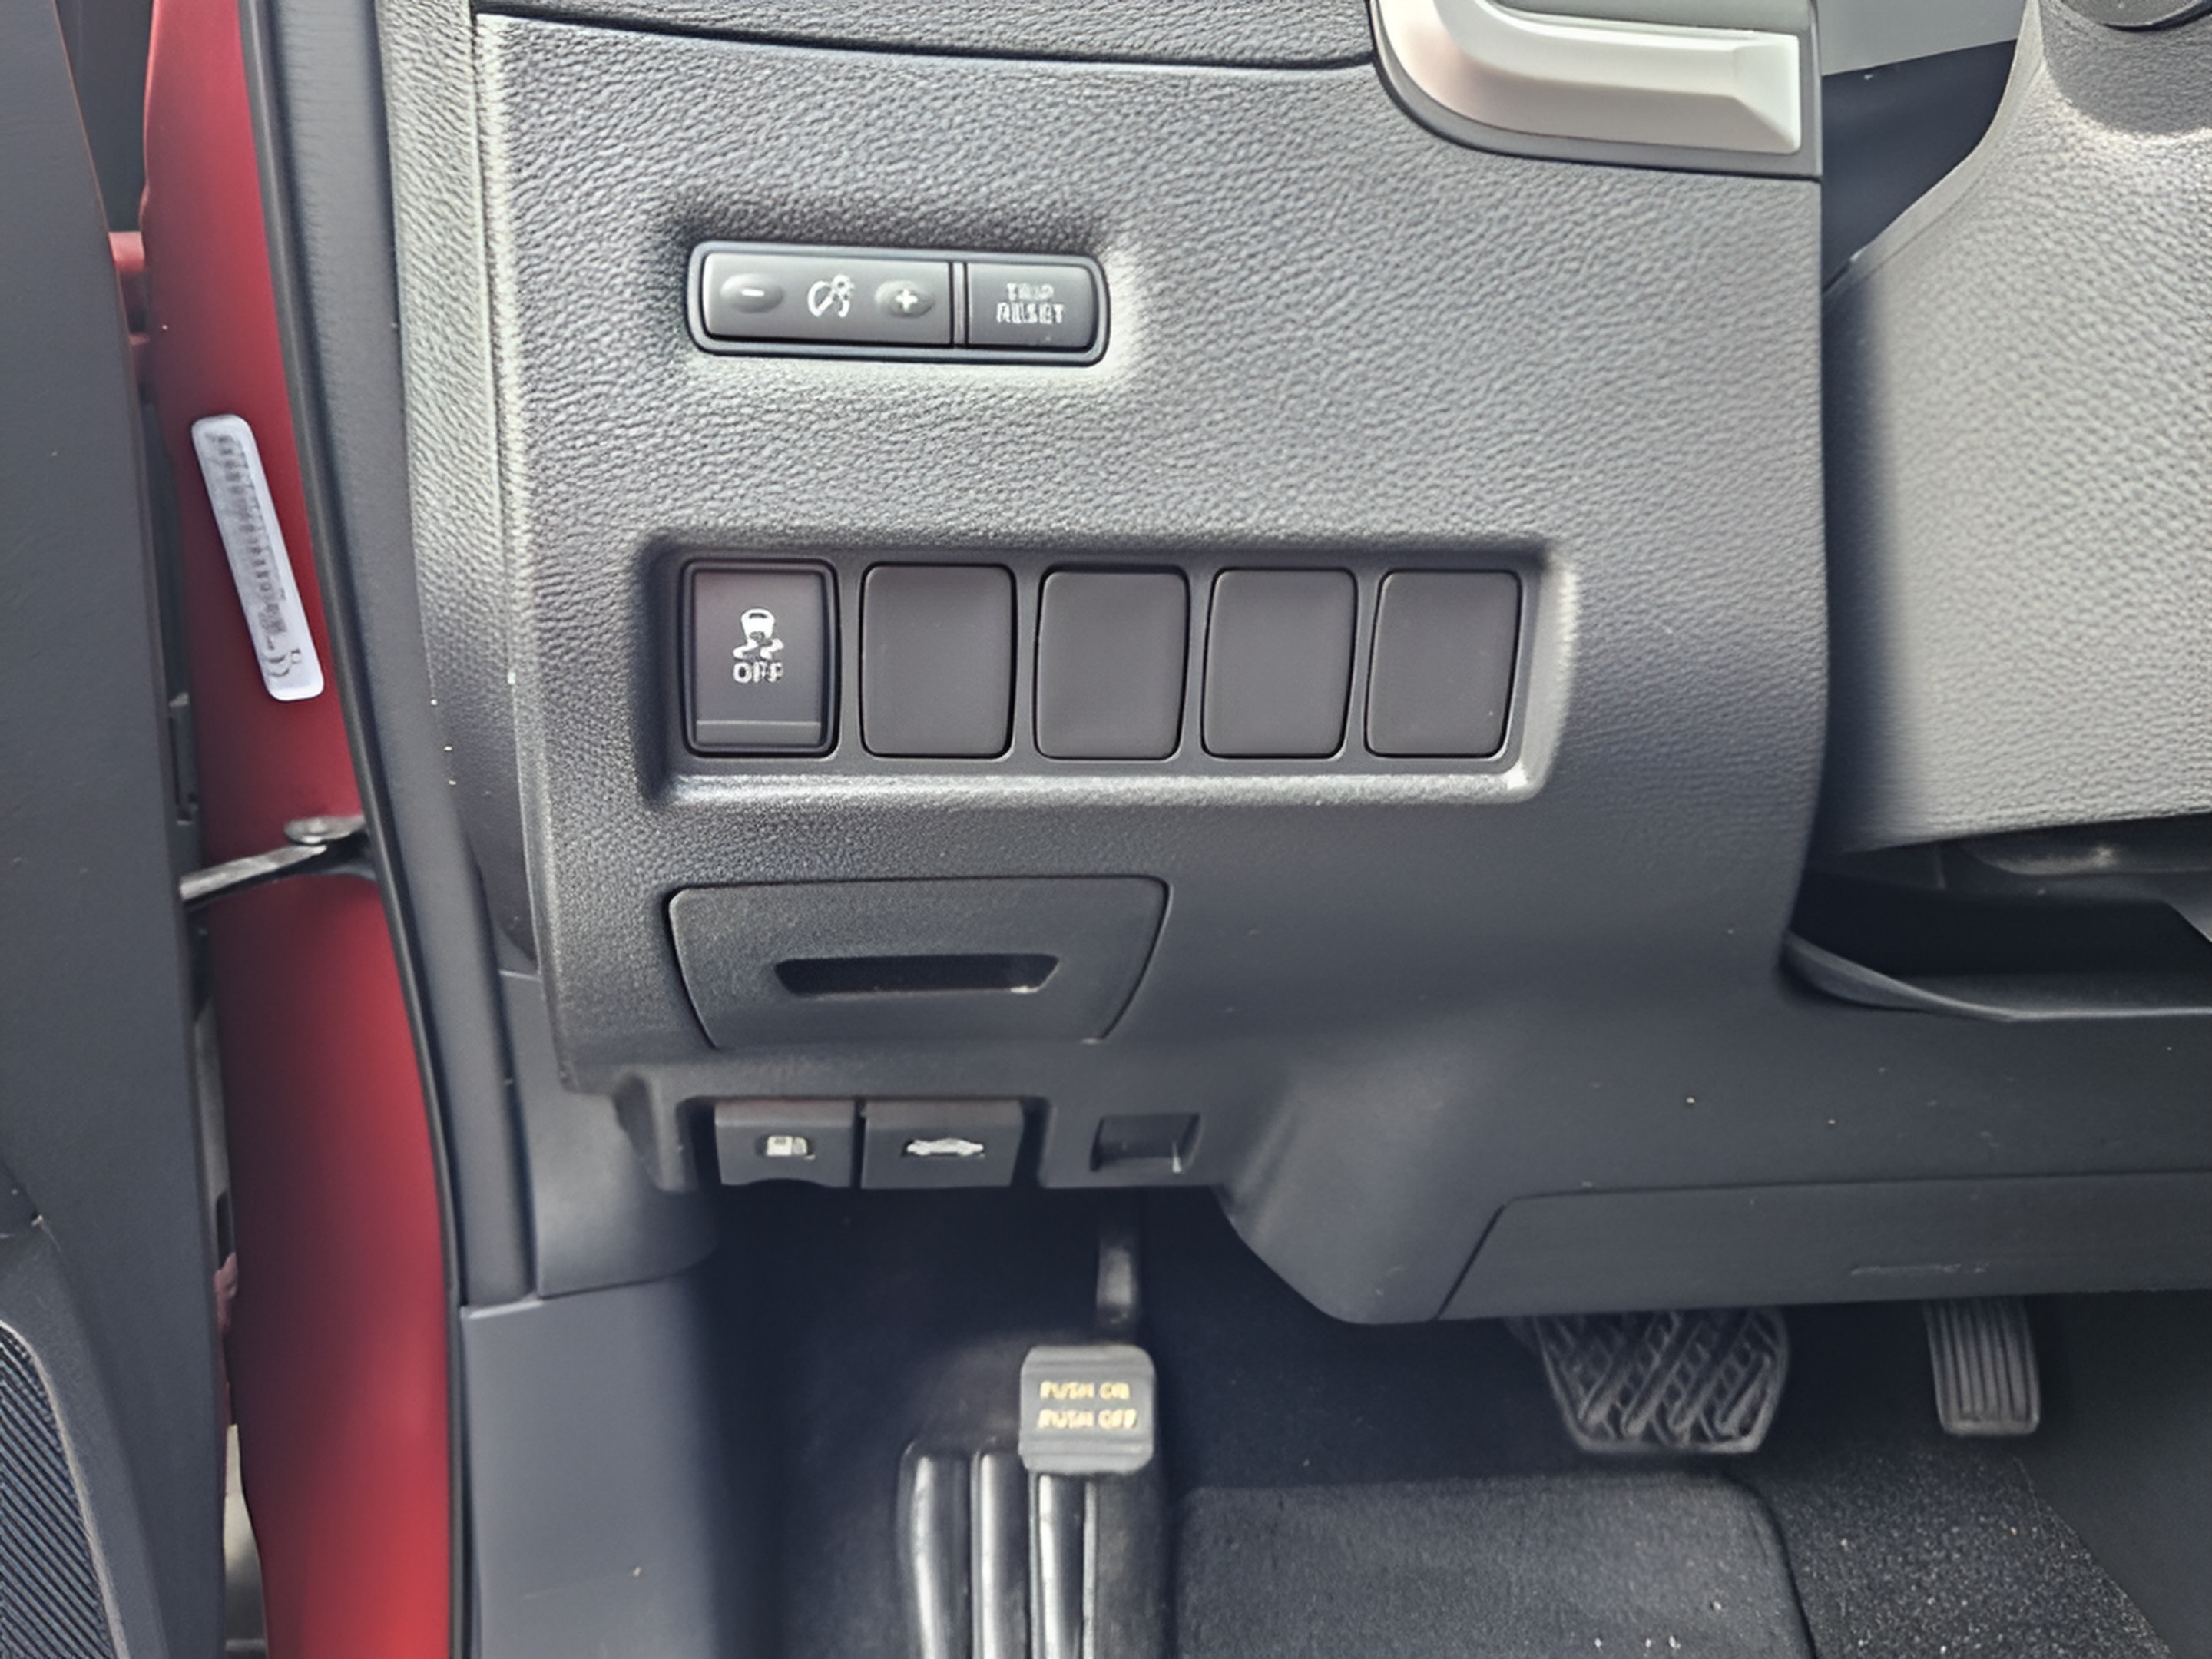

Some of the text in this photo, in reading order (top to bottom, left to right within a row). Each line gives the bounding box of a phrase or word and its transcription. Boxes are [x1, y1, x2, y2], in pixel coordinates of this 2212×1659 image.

[997, 302, 1064, 323] RESET
[733, 661, 783, 683] OFF
[1040, 1381, 1094, 1400] PUSH
[1038, 1409, 1137, 1429] PUSH OFF
